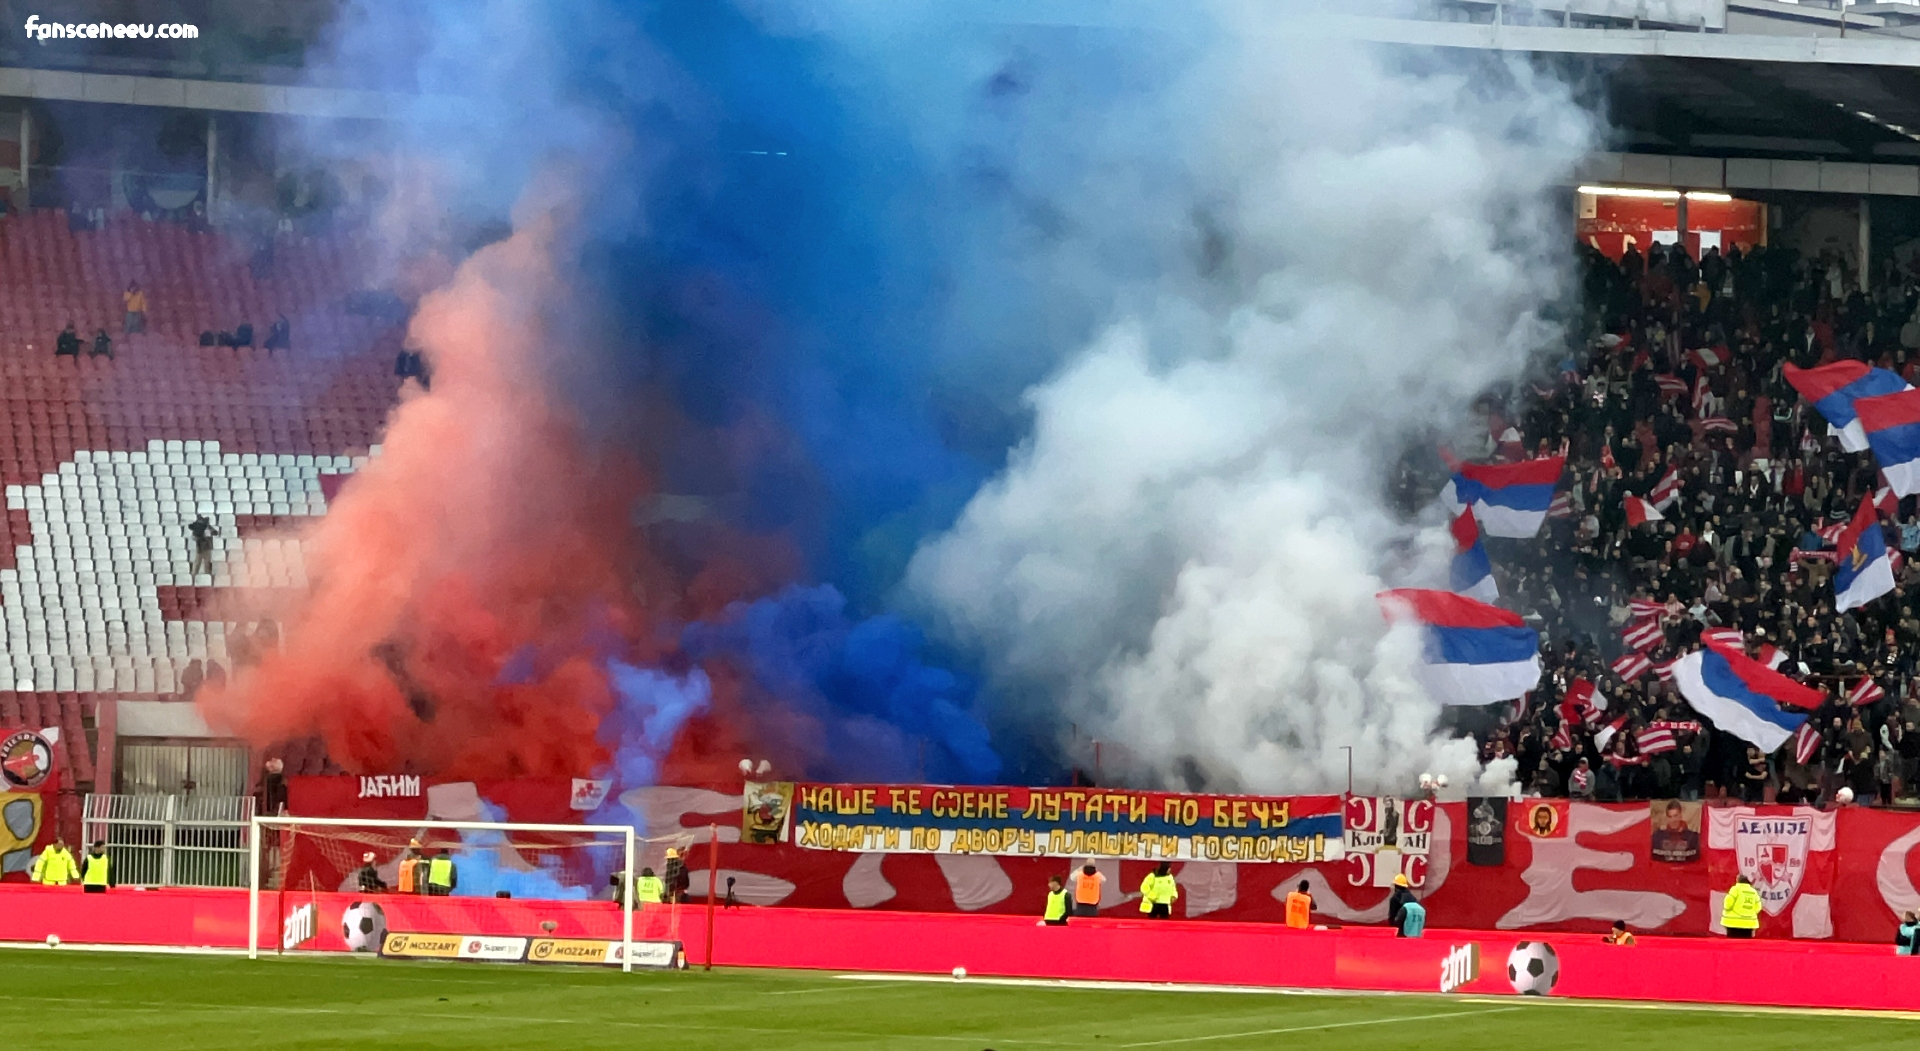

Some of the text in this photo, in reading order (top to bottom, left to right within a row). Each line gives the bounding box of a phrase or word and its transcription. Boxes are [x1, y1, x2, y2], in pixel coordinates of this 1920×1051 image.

[801, 787, 1289, 829] НАШЕ ЋЕ СЈЕНЕ ЛУТАТИ ПО БЕЧУ
[800, 820, 900, 851] ХОДАТИ
[911, 827, 942, 851] ПО
[1050, 828, 1179, 858] ПЛАШИТИ
[1190, 834, 1326, 863] ГОСПОДУ!
[1756, 887, 1791, 901] ЕВЕР
[555, 946, 604, 957] MOZZART
